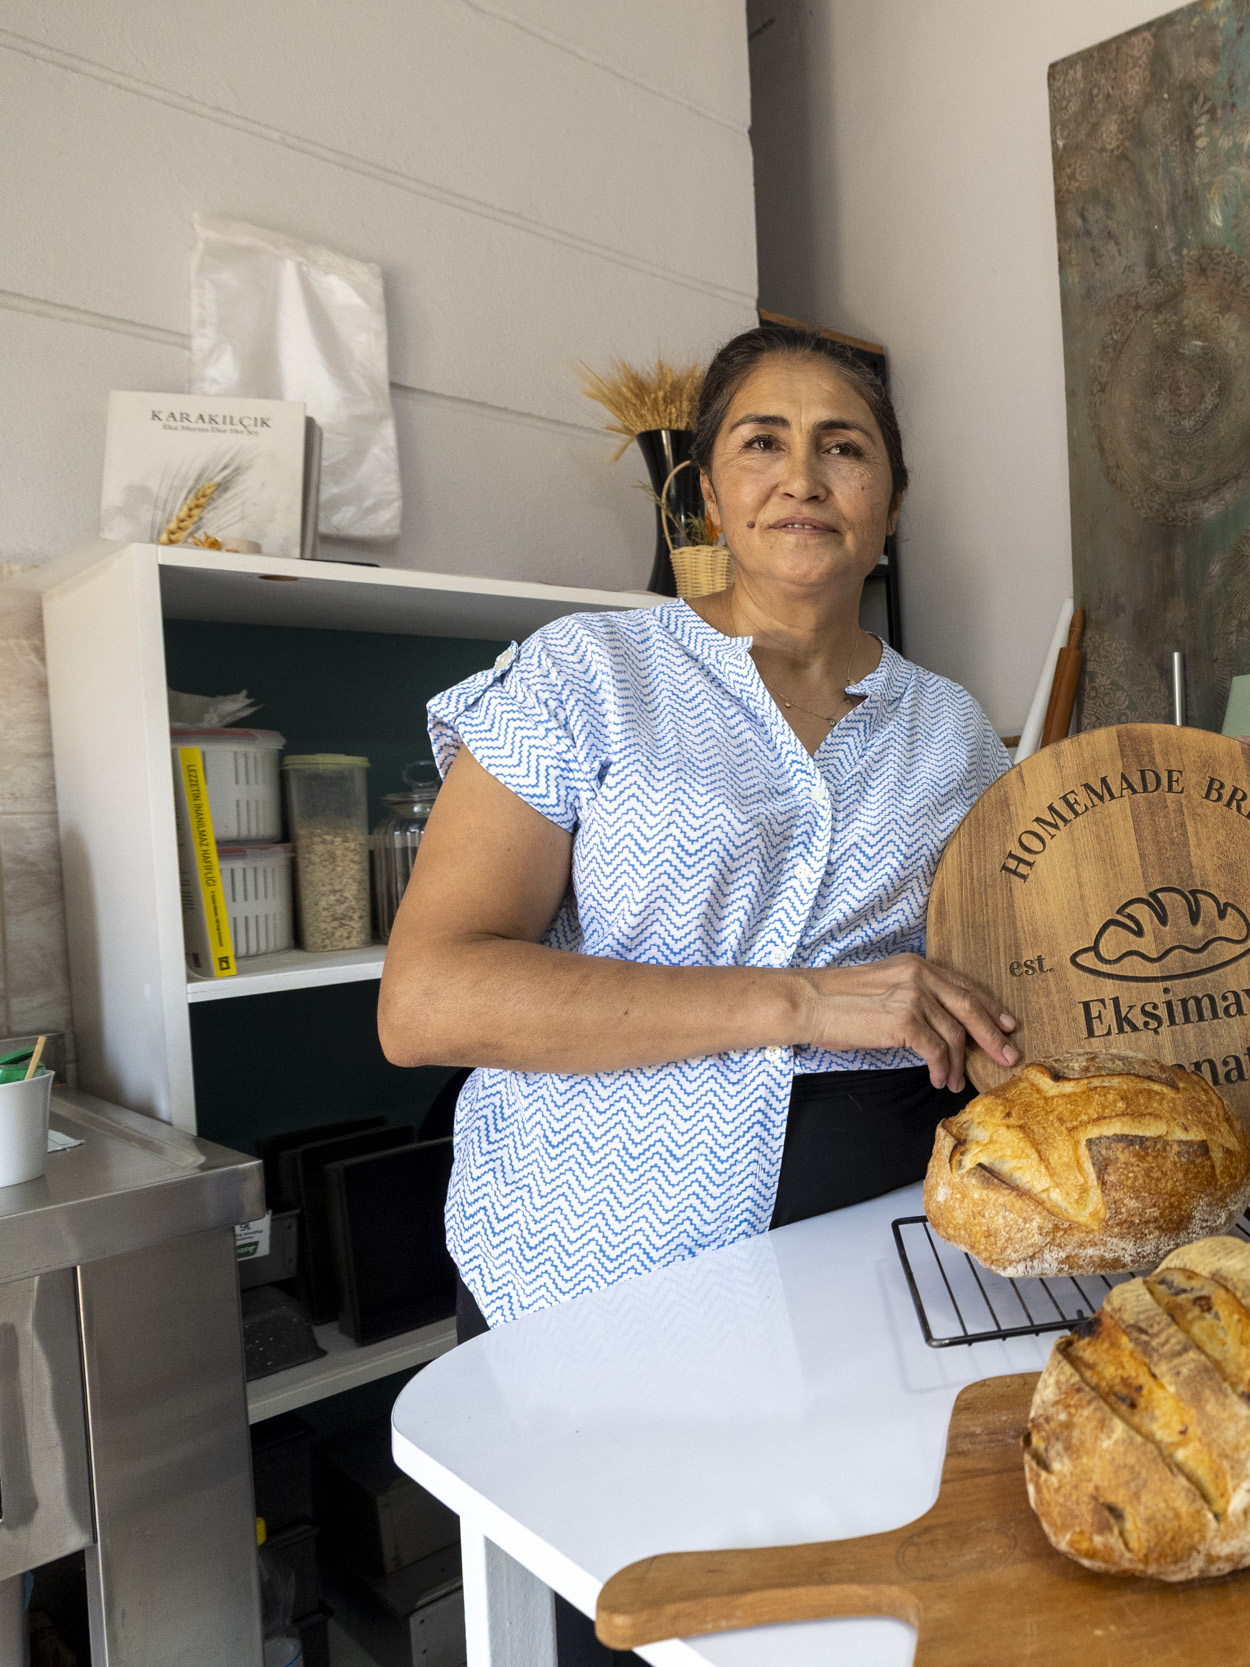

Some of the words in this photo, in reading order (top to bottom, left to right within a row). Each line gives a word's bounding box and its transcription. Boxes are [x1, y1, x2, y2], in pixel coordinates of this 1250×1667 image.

[151, 410, 271, 430] KARAKILÇIK
[1000, 769, 1185, 883] HOMEMADE
[1008, 953, 1055, 978] est.
